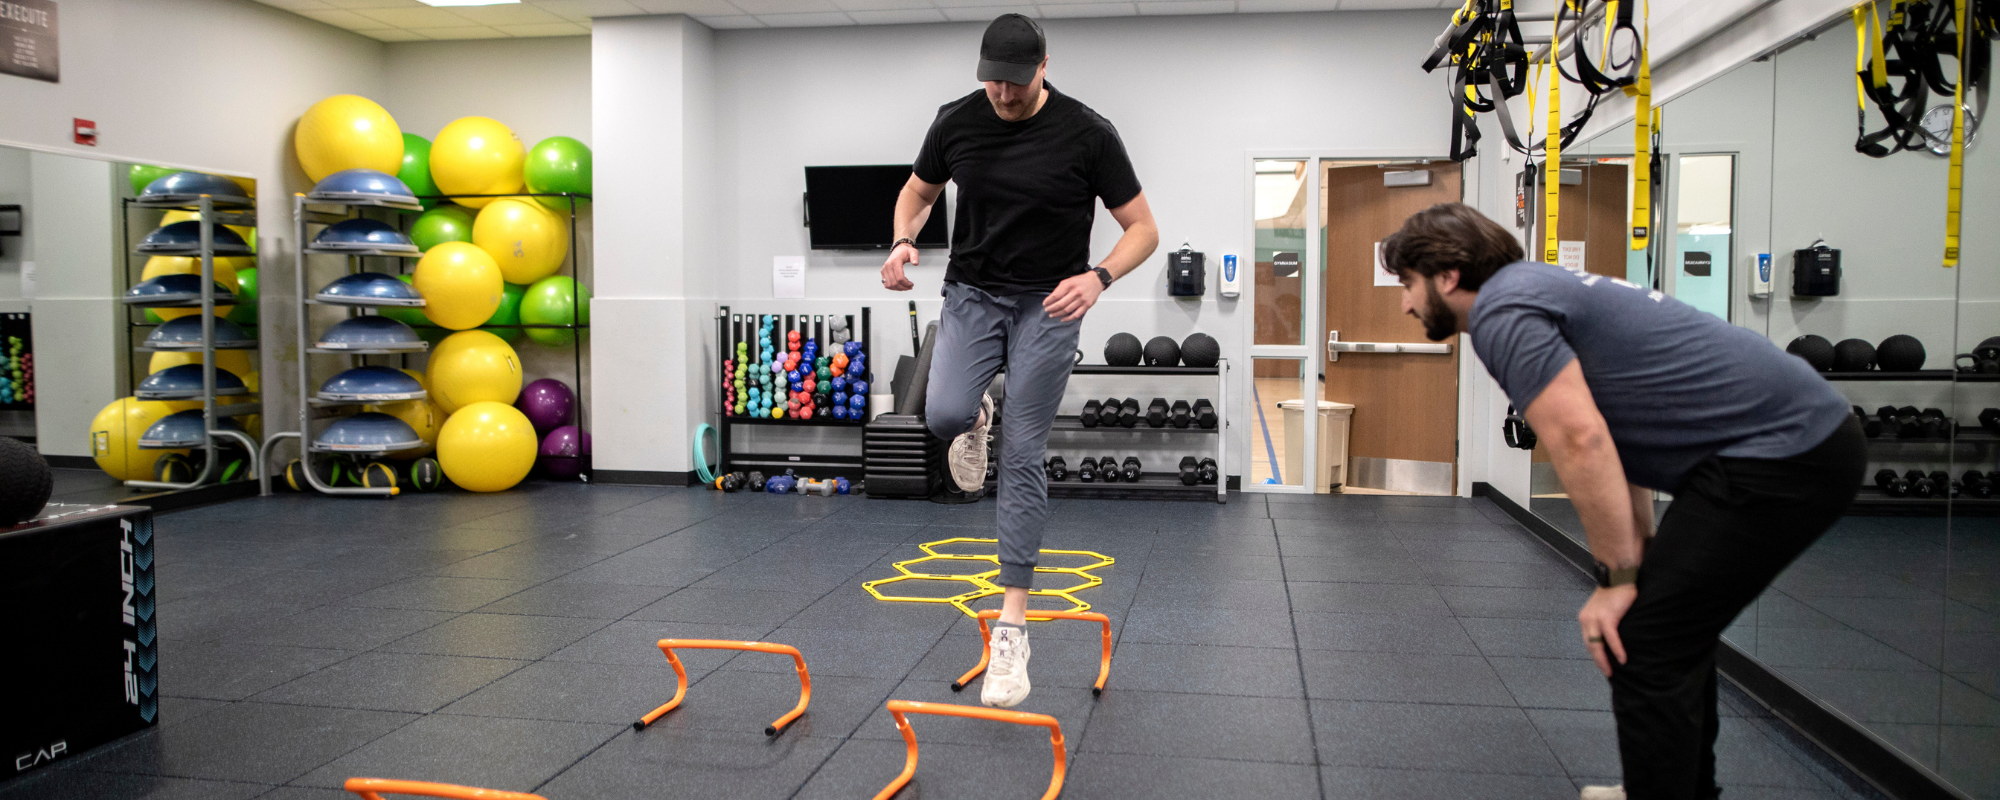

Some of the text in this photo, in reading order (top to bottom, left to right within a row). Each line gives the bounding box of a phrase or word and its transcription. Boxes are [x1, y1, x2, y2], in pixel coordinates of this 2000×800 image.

[120, 518, 139, 706] 24 INCH
[16, 740, 67, 771] CAP
